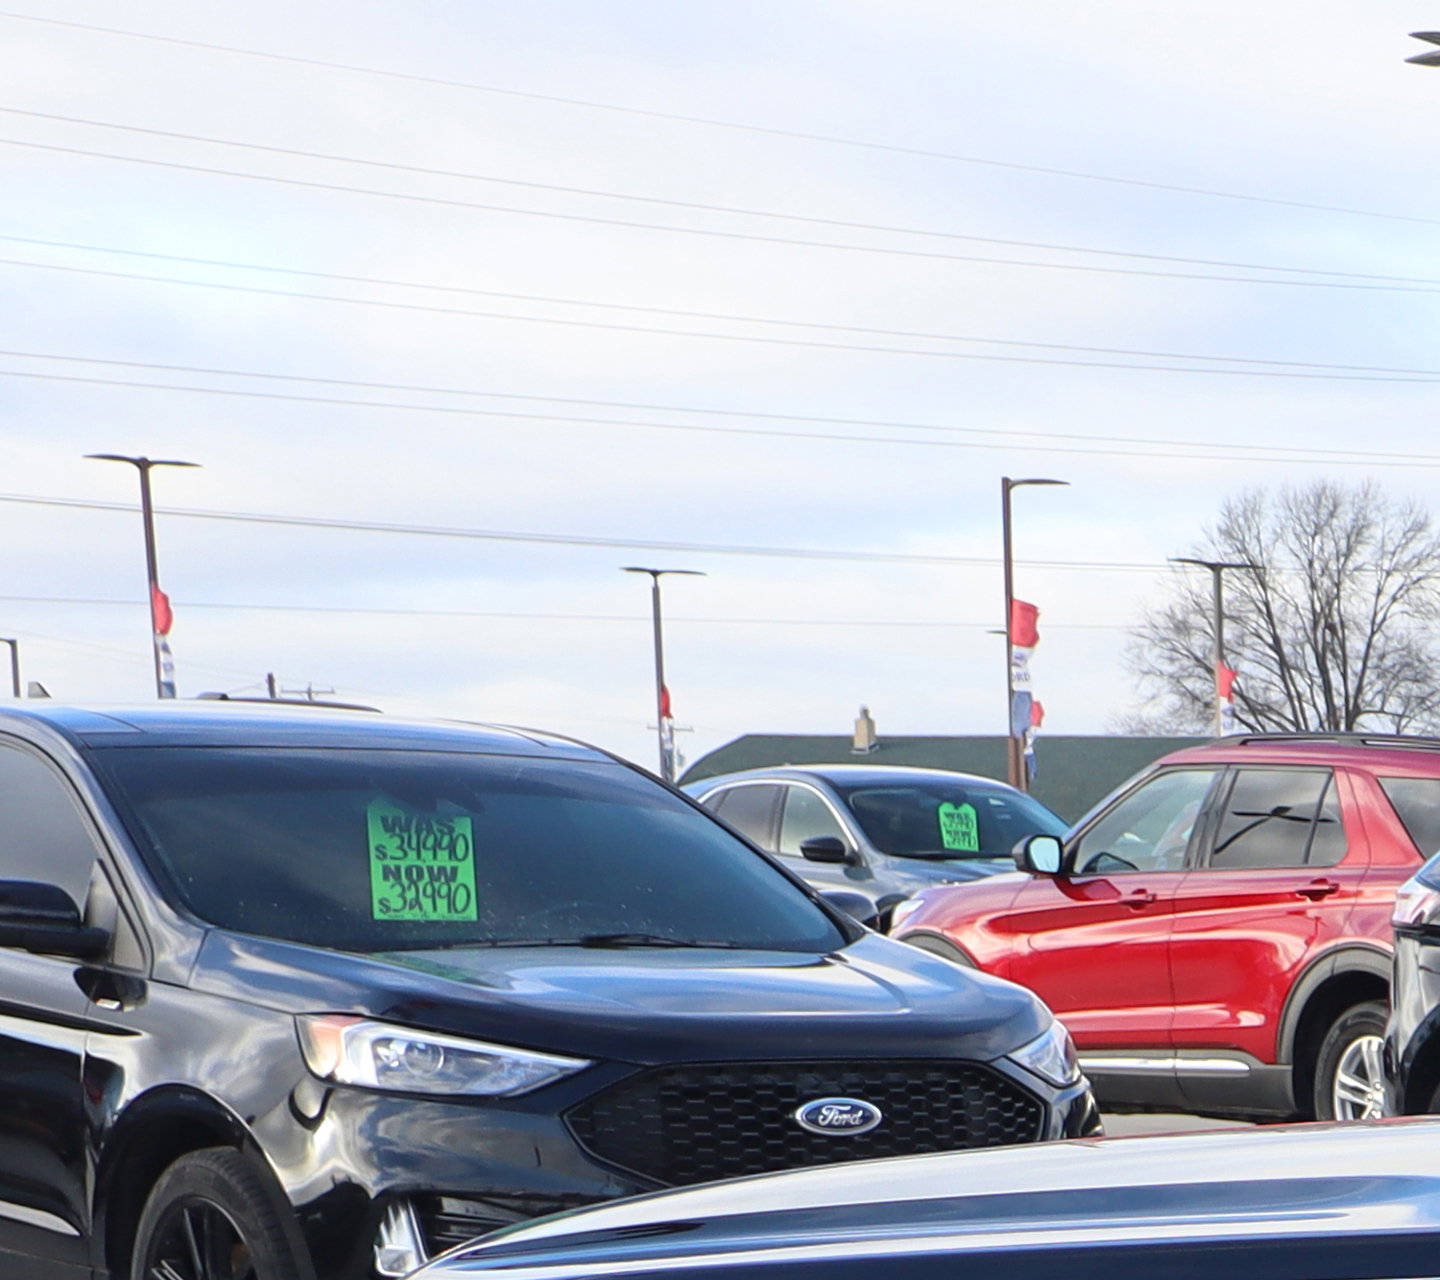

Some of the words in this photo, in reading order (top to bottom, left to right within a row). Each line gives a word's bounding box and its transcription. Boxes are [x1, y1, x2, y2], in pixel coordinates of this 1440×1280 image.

[380, 816, 455, 834] WAS
[382, 864, 459, 883] NOW
[818, 1104, 864, 1126] Ford
